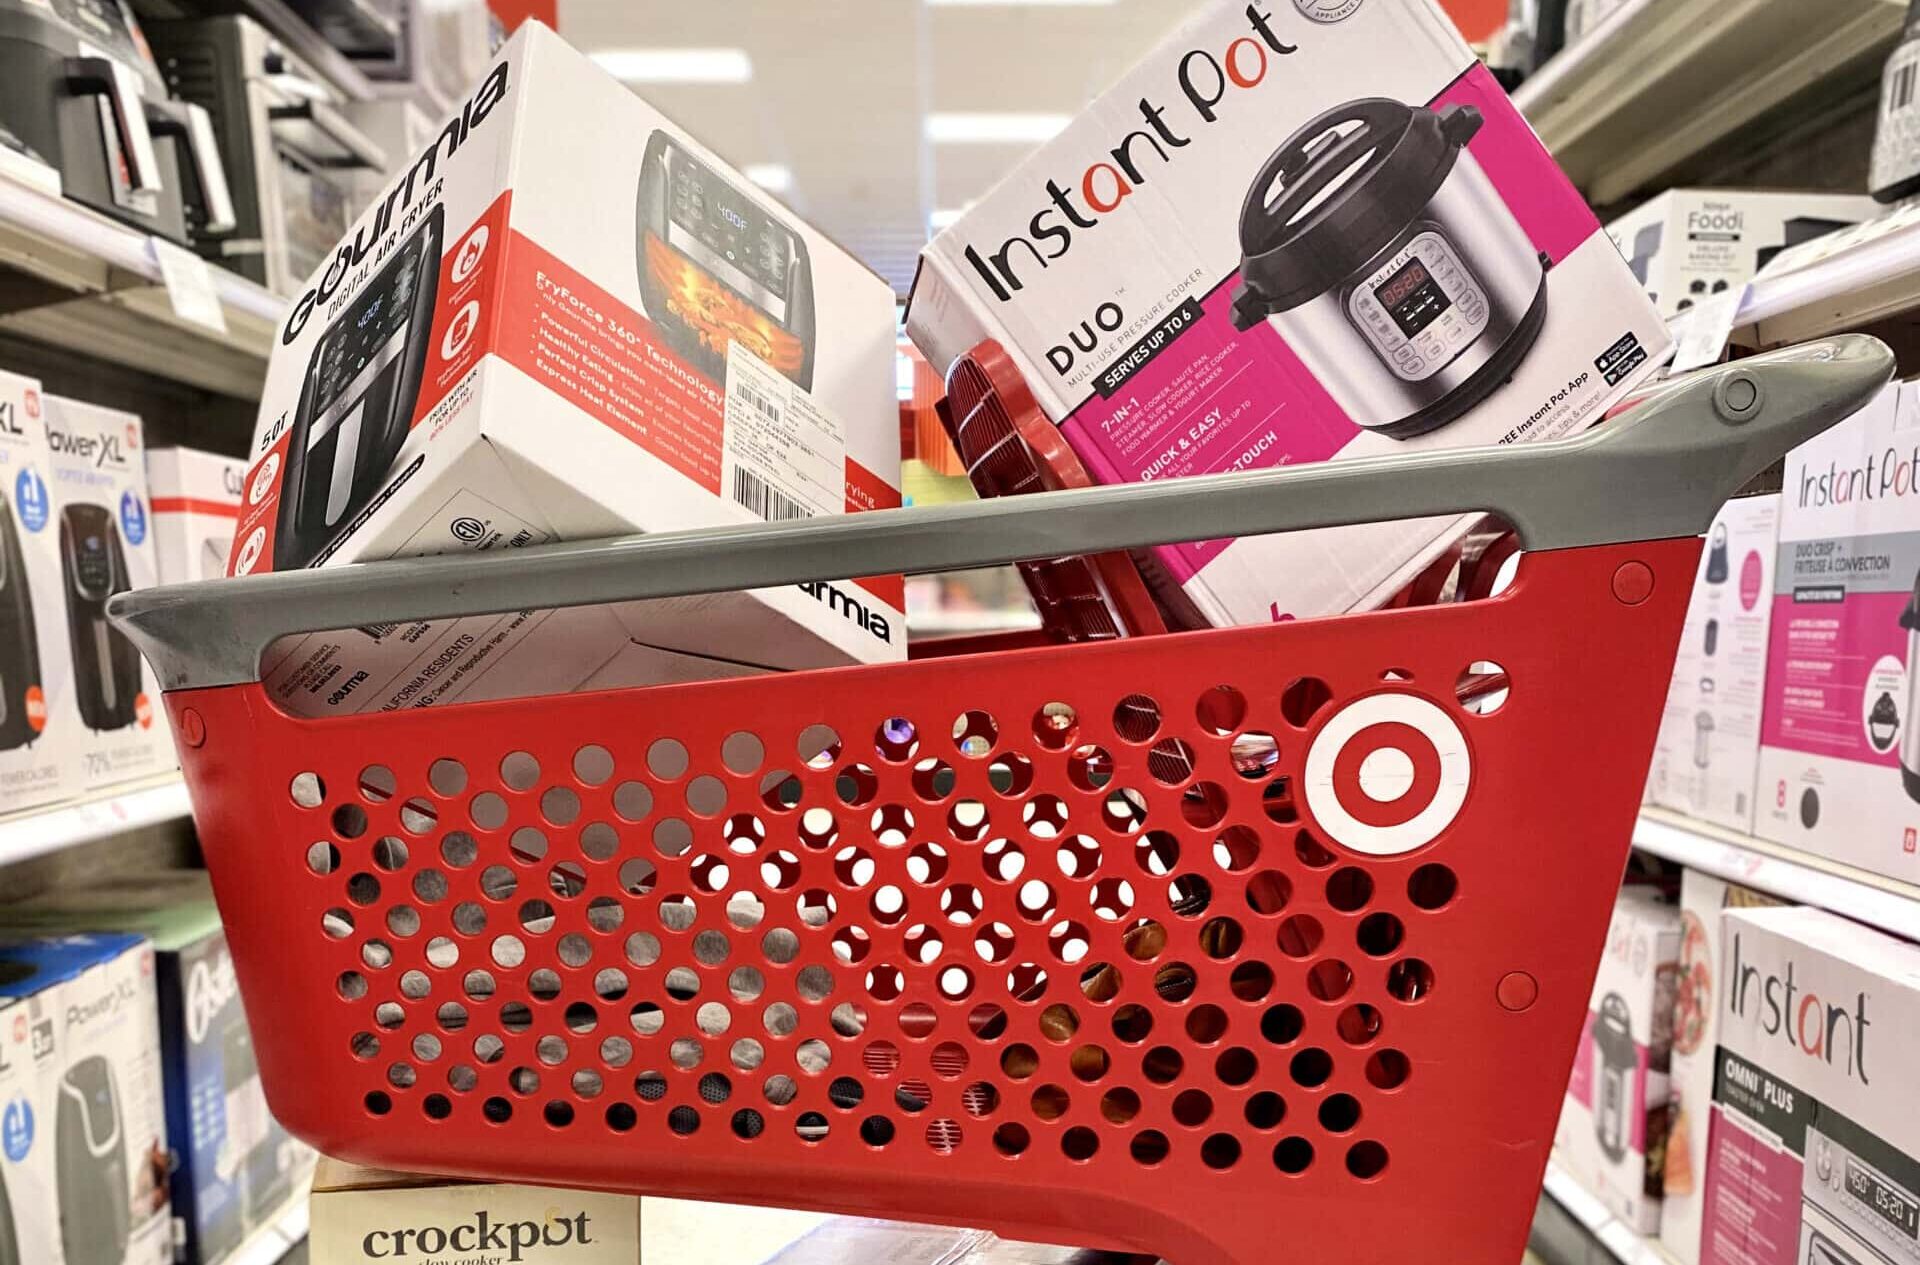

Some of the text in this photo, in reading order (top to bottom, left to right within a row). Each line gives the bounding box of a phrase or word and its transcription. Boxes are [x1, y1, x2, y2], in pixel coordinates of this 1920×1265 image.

[964, 3, 1298, 302] Instant Pot
[282, 60, 508, 346] Gourmia
[1688, 211, 1743, 230] Foodi
[327, 177, 444, 321] DIGITAL AIR FRYER
[536, 270, 604, 323] FryForce
[644, 342, 723, 405] Technology
[539, 326, 581, 361] Healthy
[581, 354, 614, 382] Eating
[541, 311, 588, 349] Powerful
[589, 343, 646, 386] Circulation
[1045, 302, 1124, 376] DUO
[1067, 268, 1204, 389] MULTI-USE PRESSURE COOKER
[1104, 309, 1192, 389] SERVES UP TO 6
[535, 357, 577, 392] Express
[579, 385, 604, 408] Heat
[605, 401, 649, 437] Element
[537, 342, 578, 373] Perfect
[578, 367, 607, 394] Crisp
[608, 387, 645, 418] System
[1121, 437, 1141, 456] FOOD
[1140, 413, 1168, 441] WARMER
[1173, 386, 1201, 411] YOGURT
[1198, 366, 1224, 390] MAKER
[1148, 403, 1167, 421] SLOW
[1194, 364, 1211, 380] RICE
[1516, 402, 1552, 434] Instant
[1550, 388, 1568, 406] Pot
[1567, 372, 1589, 392] App
[1101, 396, 1140, 433] 7-IN-1
[1109, 411, 1145, 441] PRESSURE
[1140, 406, 1222, 483] QUICK & EASY
[1180, 446, 1199, 462] YOUR
[1198, 418, 1233, 450] FAVORITES
[1229, 408, 1242, 421] UP
[1799, 446, 1920, 508] Instant Pot
[510, 529, 534, 548] ONLY
[1794, 559, 1828, 574] FRITEUSE
[1835, 555, 1890, 572] CONVECTION
[1796, 543, 1813, 558] DUO
[1814, 541, 1836, 557] CRISP
[327, 669, 371, 706] Gourmia
[380, 633, 475, 713] ALIFORNIA RESIDENTS
[461, 642, 495, 678] Reproductive
[1731, 933, 1871, 1086] Instant
[1725, 1059, 1793, 1114] OMNI PLUS
[363, 1211, 593, 1262] crockpot
